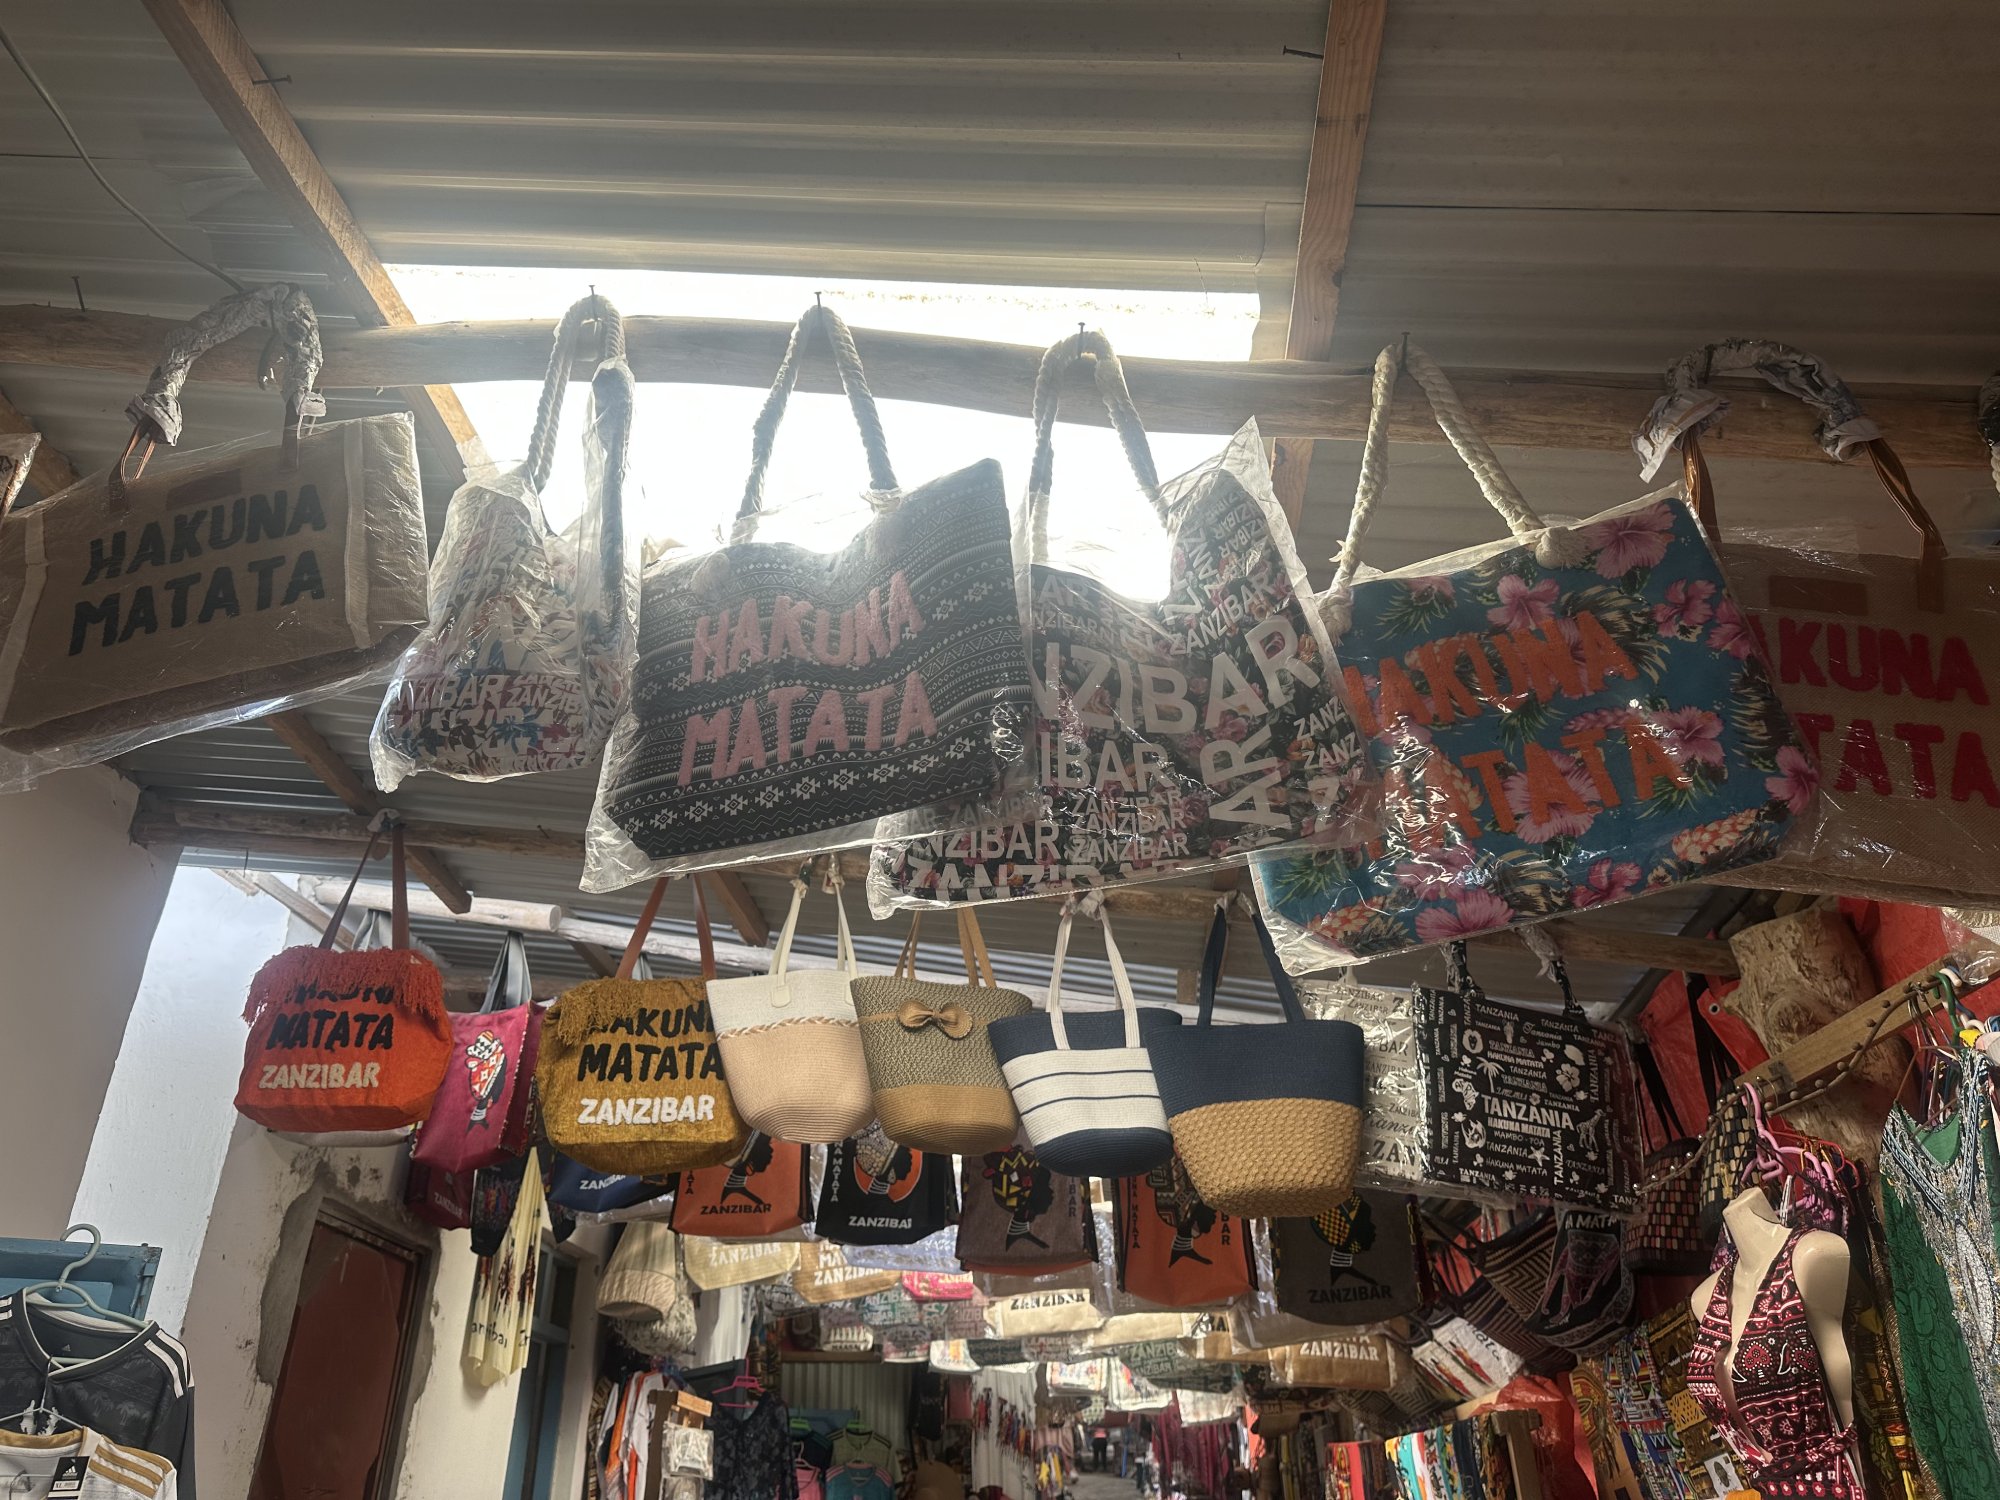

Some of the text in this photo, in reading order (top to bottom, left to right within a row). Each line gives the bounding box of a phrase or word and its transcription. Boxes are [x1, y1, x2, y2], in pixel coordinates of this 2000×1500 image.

[82, 484, 328, 586] HAKUNA
[68, 550, 325, 656] MATATA
[690, 570, 925, 683] HAKUNA
[677, 671, 937, 787] MATATA
[1072, 808, 1188, 835] ZANZIBAR
[1072, 832, 1190, 863] ZANZIBAR
[598, 1004, 715, 1039] AKUN
[1475, 1004, 1520, 1022] TANZANIA
[266, 1009, 395, 1051] MATATA
[1541, 1018, 1580, 1033] TANZANIA
[578, 1043, 724, 1082] MATATA
[1509, 1065, 1547, 1079] TANZANIA
[1515, 1055, 1544, 1069] MATATA
[259, 1062, 380, 1089] ZANZIBAR
[577, 1095, 715, 1126] ZANZIBAR
[1481, 1094, 1575, 1131] TANZANIA
[1544, 1099, 1580, 1112] TANZANIA
[1487, 1116, 1551, 1138] HAKUNA MATATA
[1493, 1130, 1524, 1142] MAMBO
[1486, 1141, 1528, 1158] TANZANIA
[1553, 1130, 1564, 1185] TANZANIA
[1459, 1168, 1496, 1182] TANZANIA
[1486, 1157, 1548, 1176] HAKUNA MATATA
[830, 1157, 843, 1202] MATATA
[701, 1203, 772, 1215] ZANZIBAR
[814, 1267, 884, 1286] ZANZIB
[1307, 1284, 1392, 1304] ZANZIBAR
[1300, 1341, 1379, 1361] ZANZIBAR
